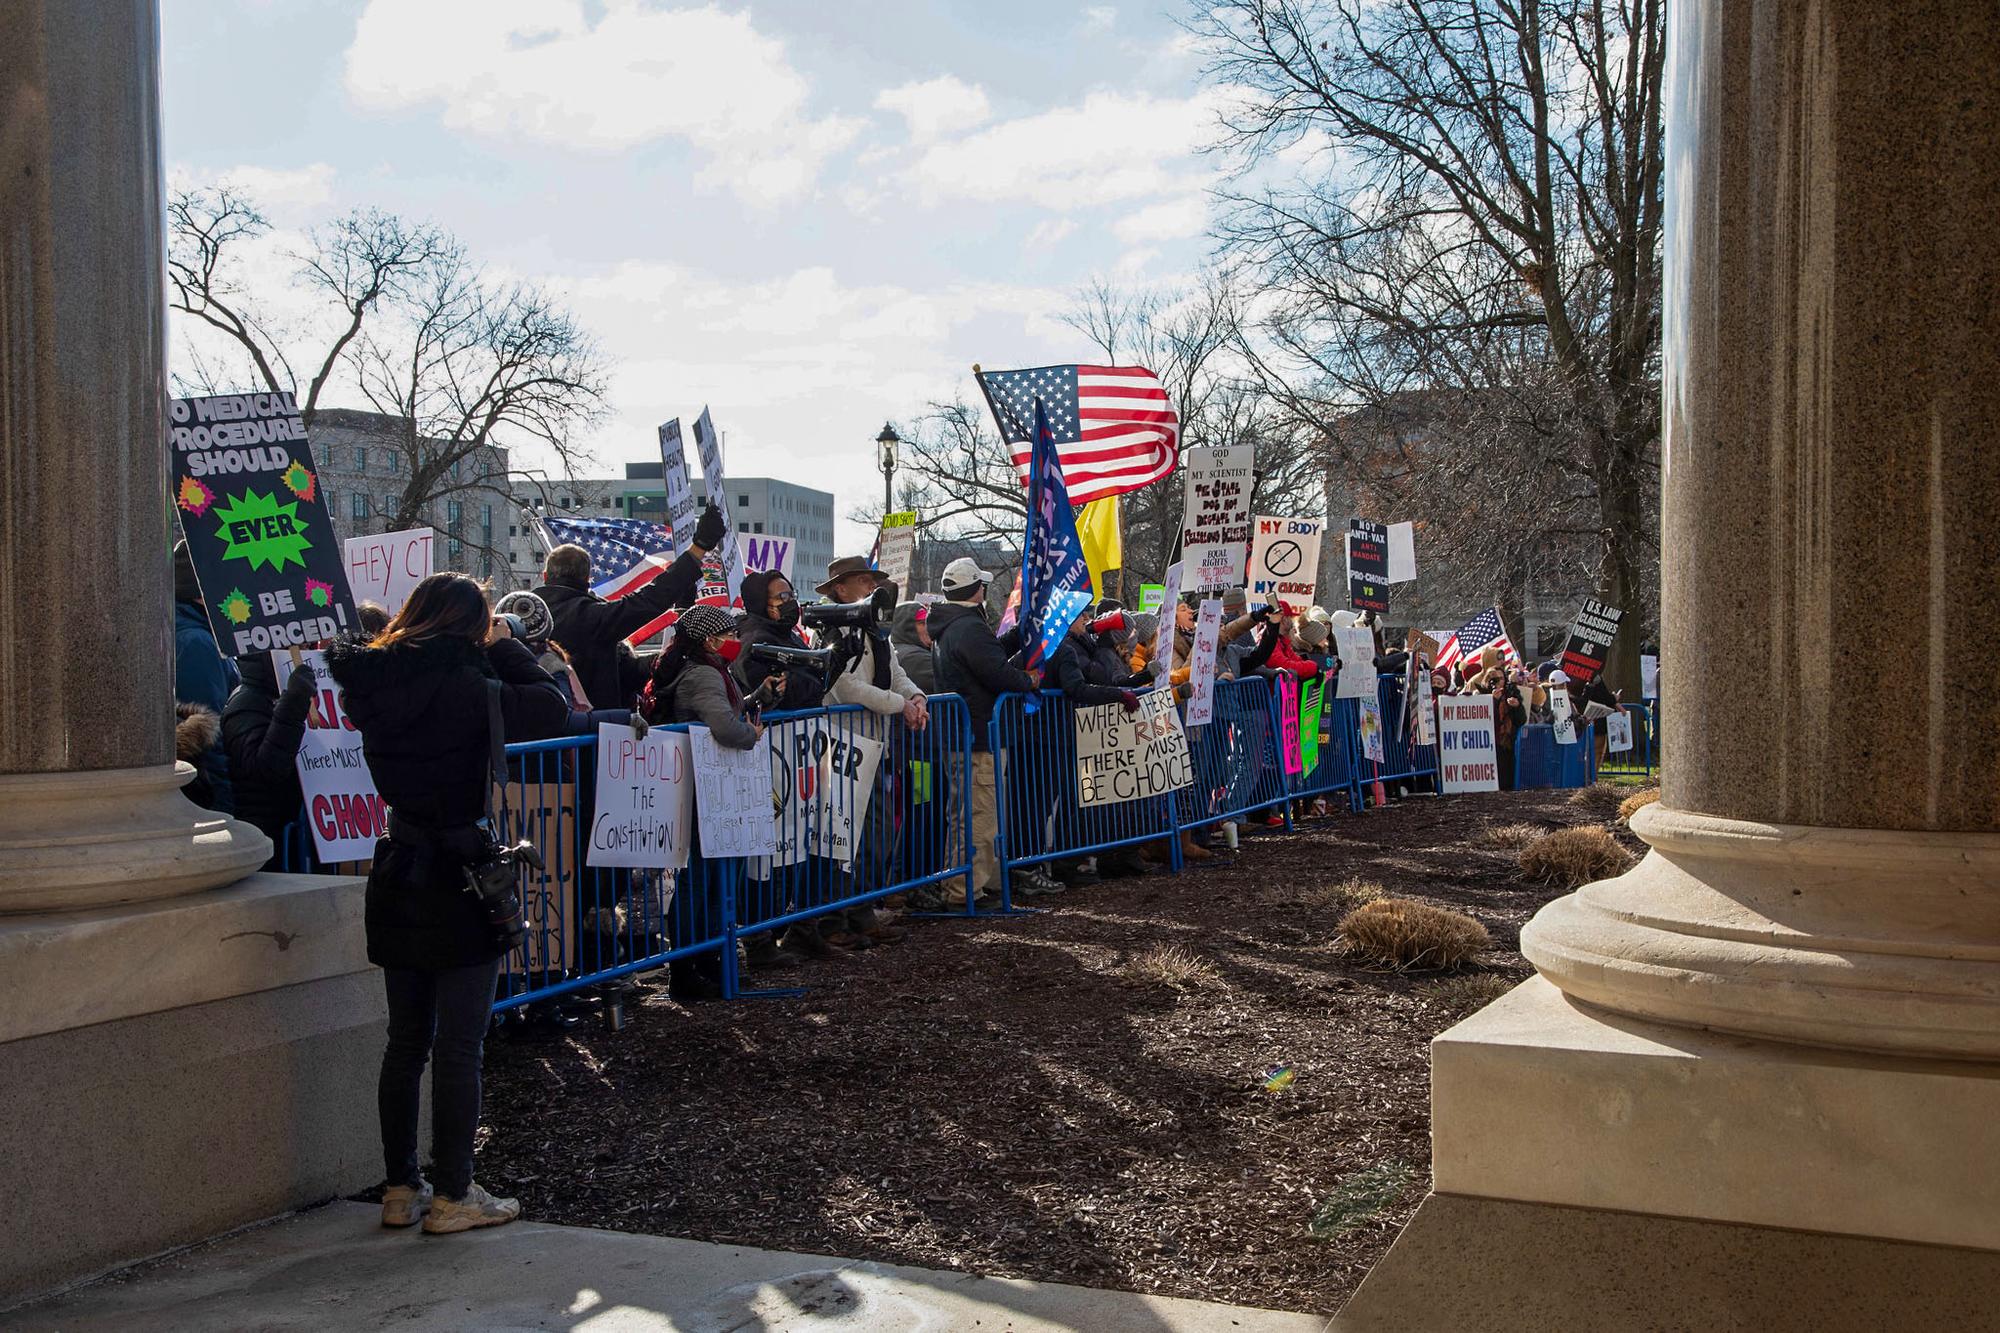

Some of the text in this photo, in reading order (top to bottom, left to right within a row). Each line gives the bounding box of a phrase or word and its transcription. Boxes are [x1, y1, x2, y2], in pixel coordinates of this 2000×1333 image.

[171, 392, 299, 424] O MEDICAL
[187, 446, 289, 477] SHOULD
[1212, 449, 1229, 458] GOD
[1216, 459, 1224, 467] IS
[1191, 468, 1247, 480] MY SCIENTIST
[229, 513, 298, 545] EVER
[1261, 521, 1319, 535] MY BODY
[1350, 529, 1385, 544] ANTI-VAX
[1359, 521, 1376, 532] NOT
[747, 538, 788, 572] MY
[1202, 558, 1228, 567] RIGHTS
[1207, 549, 1227, 559] EQUAL
[352, 536, 432, 596] HEY CT
[1349, 569, 1389, 585] PRO-CHOICE
[701, 586, 728, 597] REA
[1197, 582, 1231, 593] CHILDREN
[1255, 581, 1314, 594] MY CHOICE
[258, 589, 296, 616] BE
[1586, 600, 1623, 621] U.S. LAW
[234, 603, 348, 655] FORCED!
[1579, 612, 1619, 634] CLASSIFIES
[1573, 624, 1613, 647] VACCINES
[1580, 642, 1594, 655] AS
[306, 689, 357, 732] RIS
[1443, 704, 1492, 721] MY RELIGION,
[1100, 713, 1178, 749] IS RISK
[1443, 729, 1494, 752] MY CHILD,
[298, 745, 362, 771] There MUST
[608, 739, 684, 784] UPHOLD
[1079, 734, 1184, 774] THERE MUST
[1081, 751, 1194, 803] BE CHOICE
[1445, 763, 1495, 782] MY CHOICE
[312, 794, 388, 841] CHOIC
